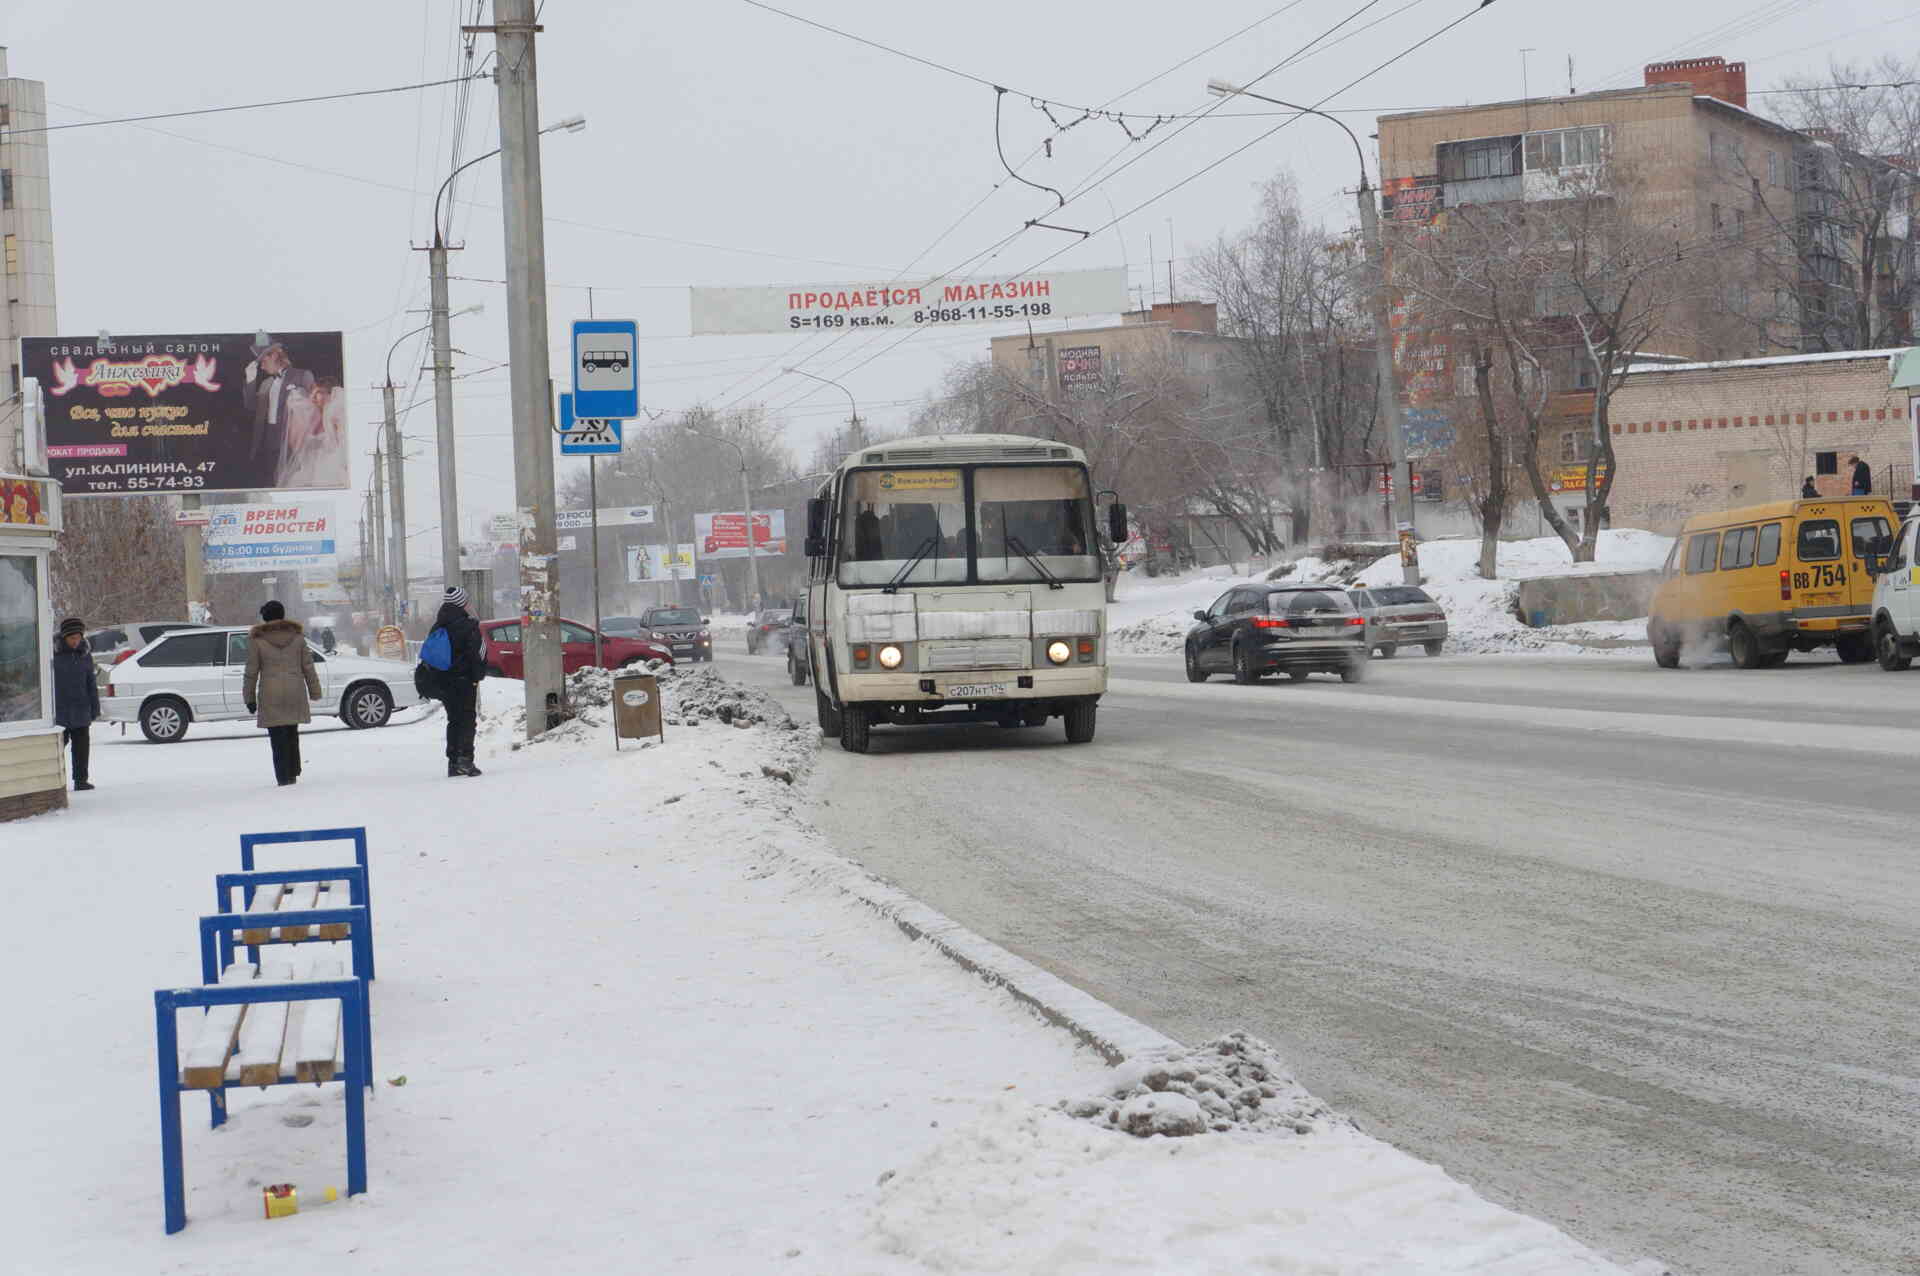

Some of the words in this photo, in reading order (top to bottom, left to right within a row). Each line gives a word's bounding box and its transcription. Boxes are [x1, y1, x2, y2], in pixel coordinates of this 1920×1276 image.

[788, 286, 921, 311] ПРОДАЁТСЯ
[944, 280, 1050, 302] МАГАЗИН
[790, 314, 844, 329] S=169
[850, 315, 894, 327] кв.м.
[914, 302, 1051, 323] 8-968-11-55-198
[50, 342, 155, 356] свадебный
[165, 343, 220, 353] салон
[93, 363, 181, 382] Анжелика
[70, 405, 101, 422] Все,
[105, 407, 136, 418] что
[138, 406, 188, 422] нужно
[111, 421, 139, 437] для
[142, 420, 209, 436] счастья!
[77, 447, 121, 456] ПРОДАЖА
[65, 463, 192, 478] ул.КАЛИНИНА,
[197, 461, 216, 473] 47
[88, 480, 122, 490] тел.
[127, 476, 204, 489] 55-74-93
[245, 507, 299, 522] ВРЕМЯ
[566, 511, 592, 520] FOCU
[243, 517, 326, 535] НОВОСТЕЙ
[256, 545, 270, 554] по
